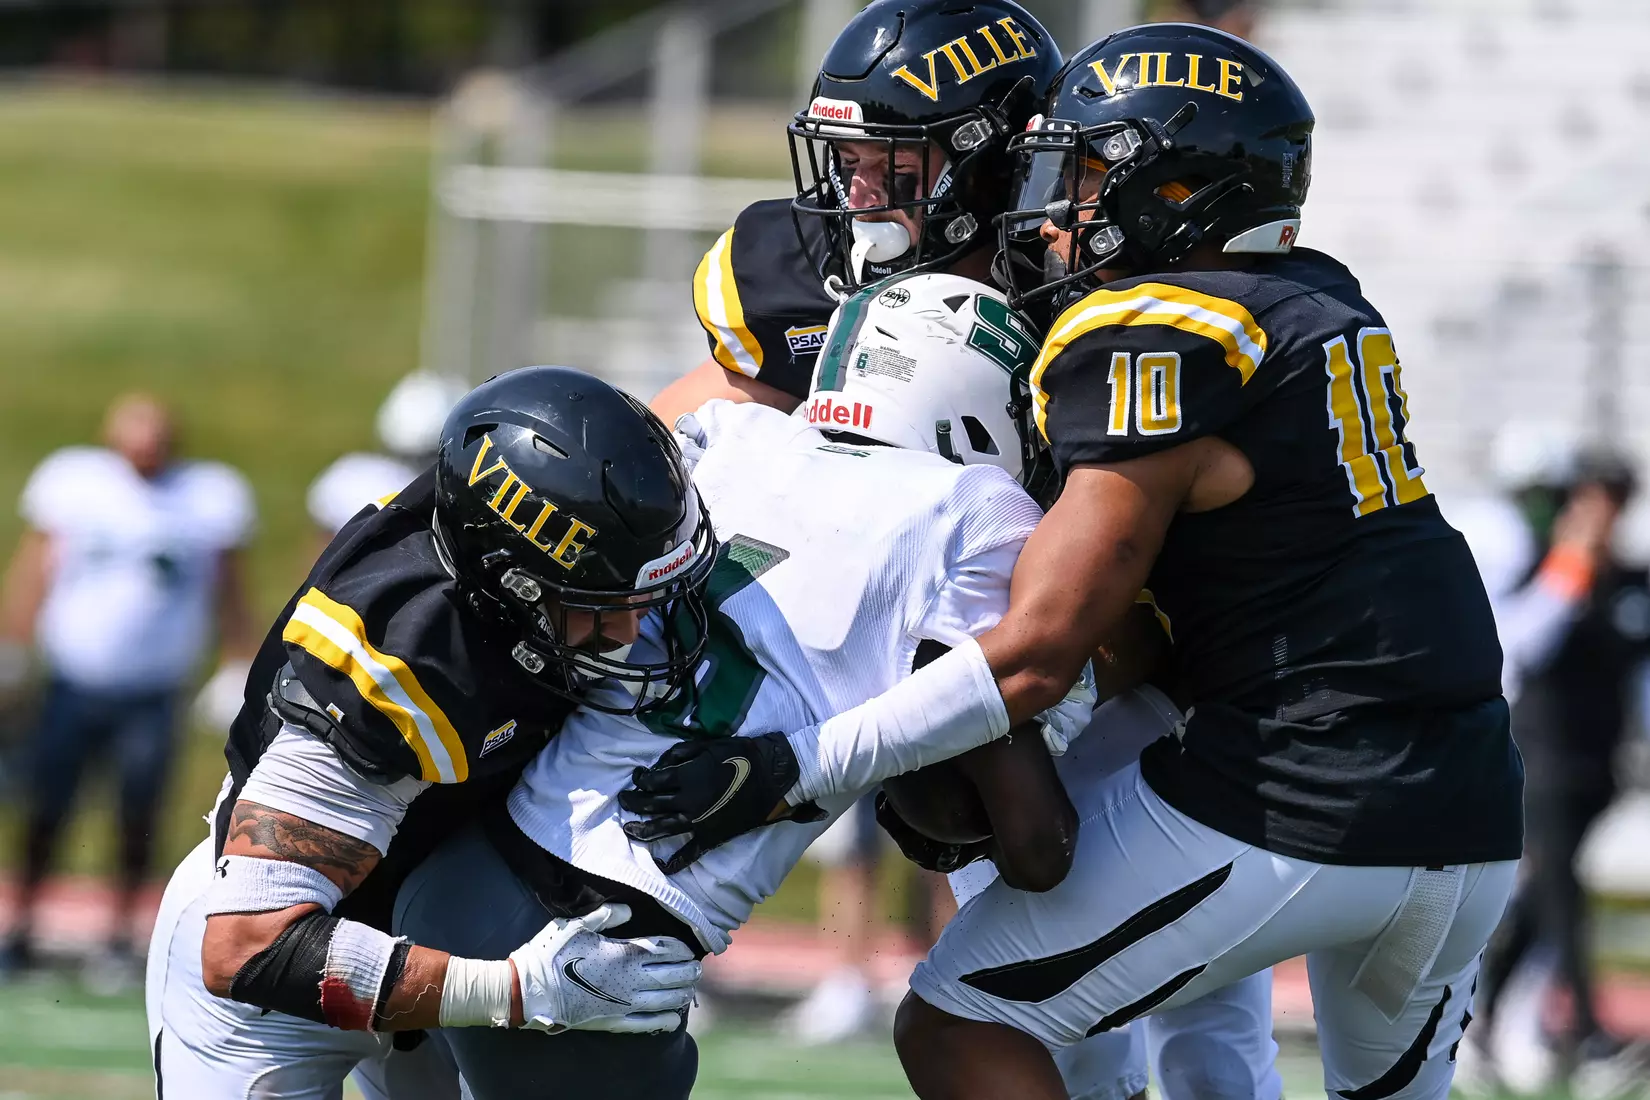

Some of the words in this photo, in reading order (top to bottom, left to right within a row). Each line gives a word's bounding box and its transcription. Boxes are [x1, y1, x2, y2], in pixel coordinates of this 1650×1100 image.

[889, 16, 1037, 102] VILLE
[1087, 52, 1244, 101] VILLE
[812, 103, 853, 120] Riddell
[856, 352, 869, 369] 6
[1106, 351, 1181, 436] 10
[1322, 326, 1426, 519] 10
[468, 432, 598, 571] VILLE
[648, 545, 692, 581] Riddell
[484, 725, 515, 752] PSAC
